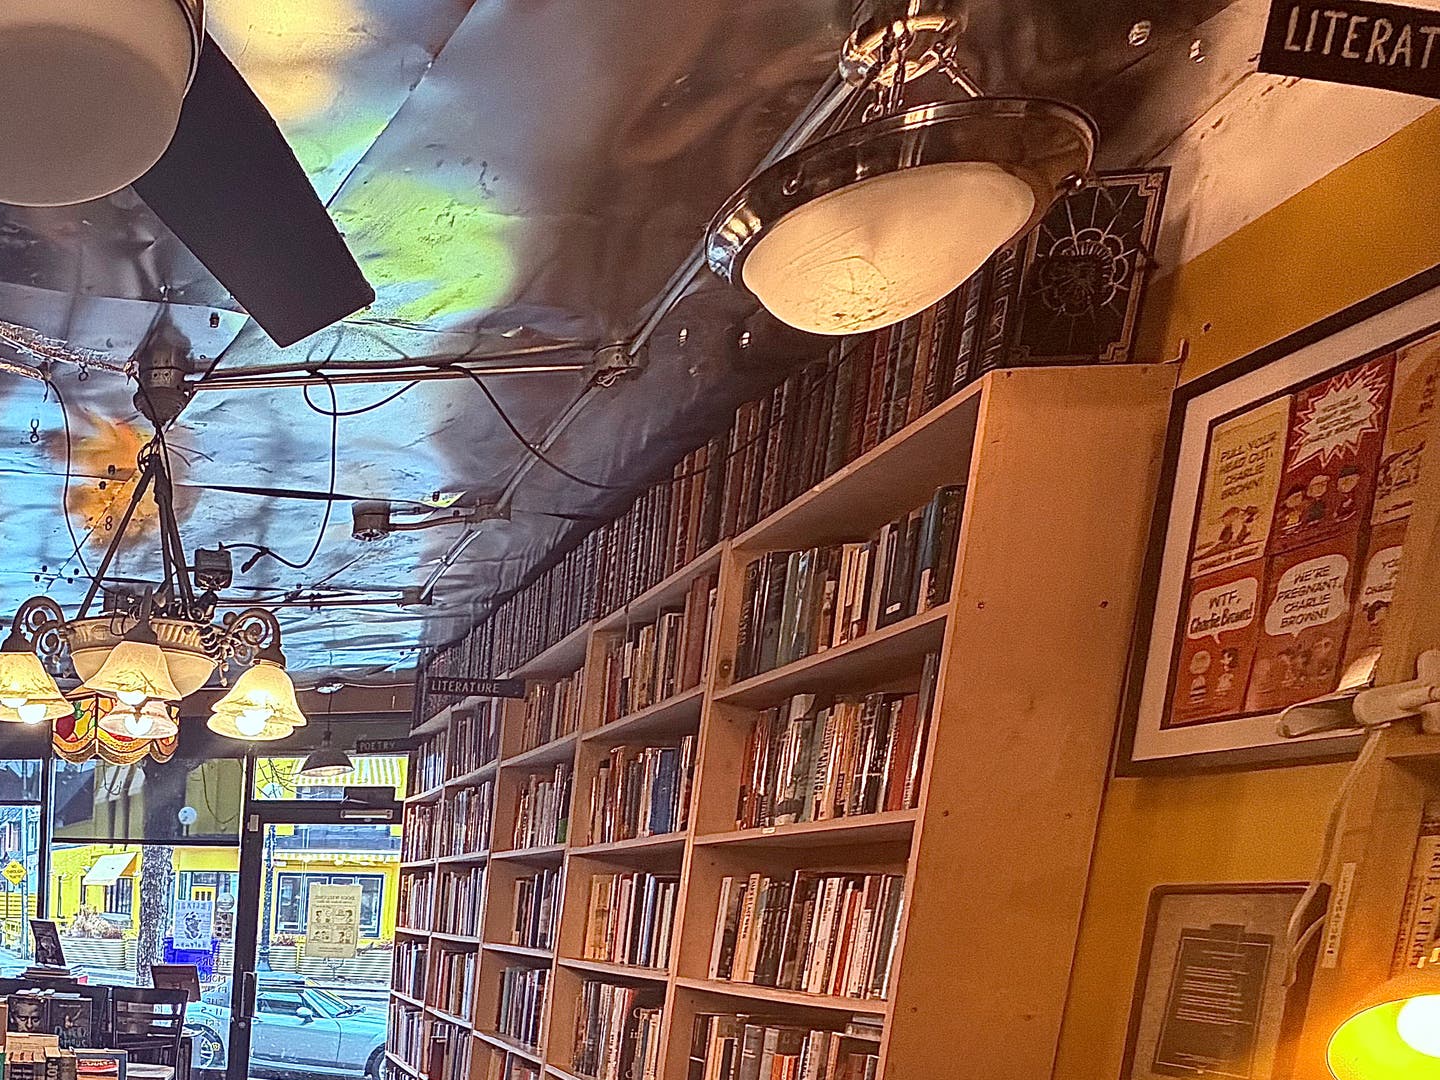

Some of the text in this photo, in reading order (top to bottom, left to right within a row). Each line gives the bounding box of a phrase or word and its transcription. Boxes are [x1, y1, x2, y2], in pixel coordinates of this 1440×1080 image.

[1284, 5, 1440, 69] LITERAT
[431, 680, 500, 694] LITERATURE
[360, 741, 396, 751] POETRY
